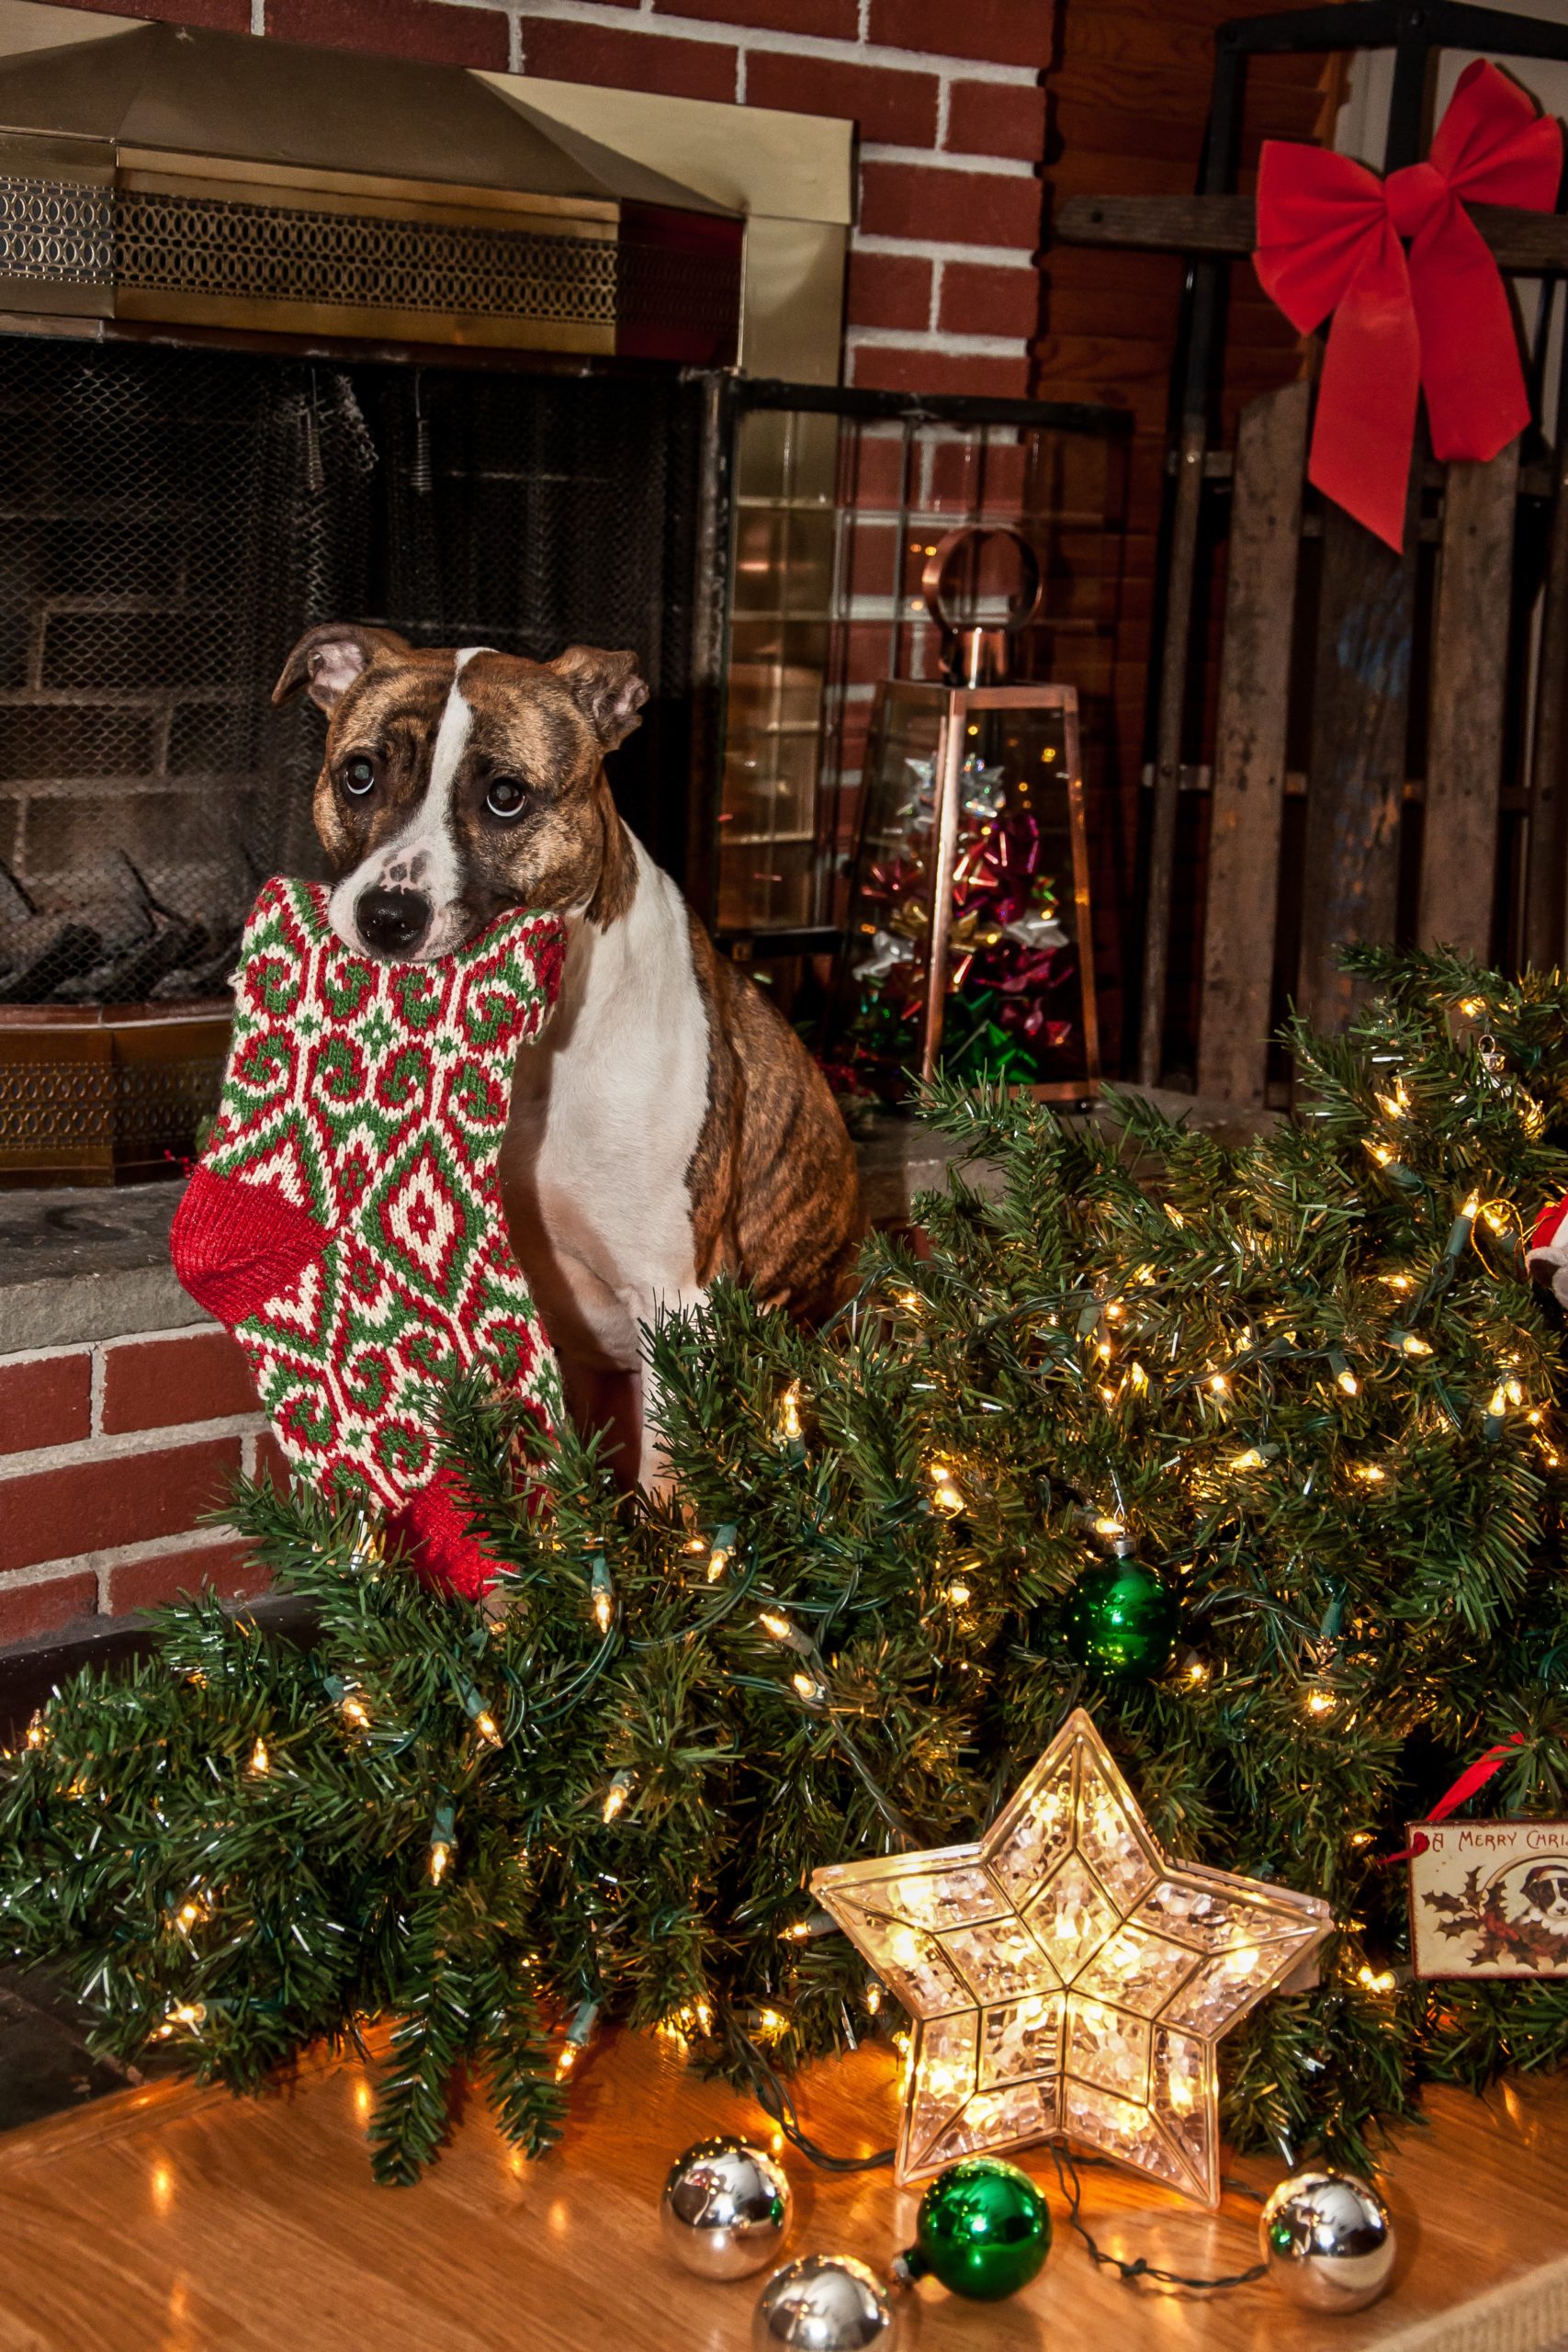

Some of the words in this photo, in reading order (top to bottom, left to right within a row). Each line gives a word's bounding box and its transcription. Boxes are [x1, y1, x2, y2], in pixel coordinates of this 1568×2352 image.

[1432, 1832, 1444, 1852] A
[1458, 1830, 1517, 1852] MERRY
[1526, 1829, 1568, 1849] CHRI
